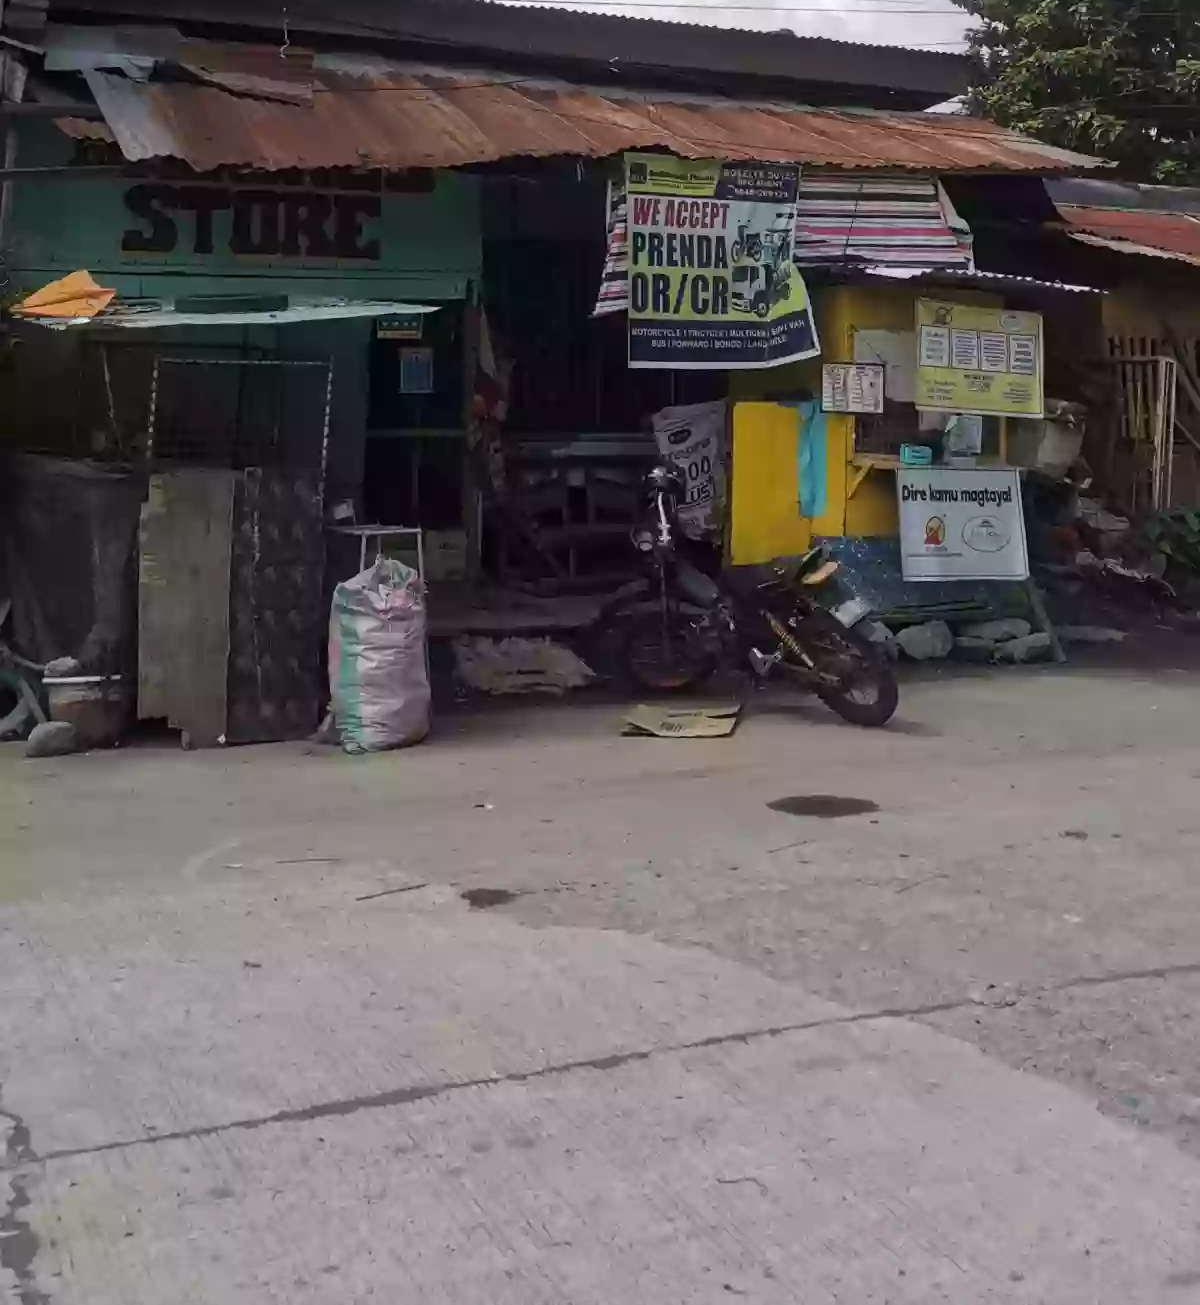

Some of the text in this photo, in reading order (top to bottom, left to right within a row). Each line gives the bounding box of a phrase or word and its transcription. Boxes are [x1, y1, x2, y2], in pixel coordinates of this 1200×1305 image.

[121, 183, 381, 260] STORE
[633, 197, 730, 229] WE ACCEPT
[632, 231, 729, 269] PRENDA
[631, 272, 729, 315] OR/CR
[631, 327, 681, 337] MOTORCYCLE
[788, 319, 805, 329] VAN
[651, 339, 667, 348] BUS
[688, 456, 711, 480] 00
[690, 483, 711, 501] US
[901, 484, 1013, 507] Dire kamu magtayal
